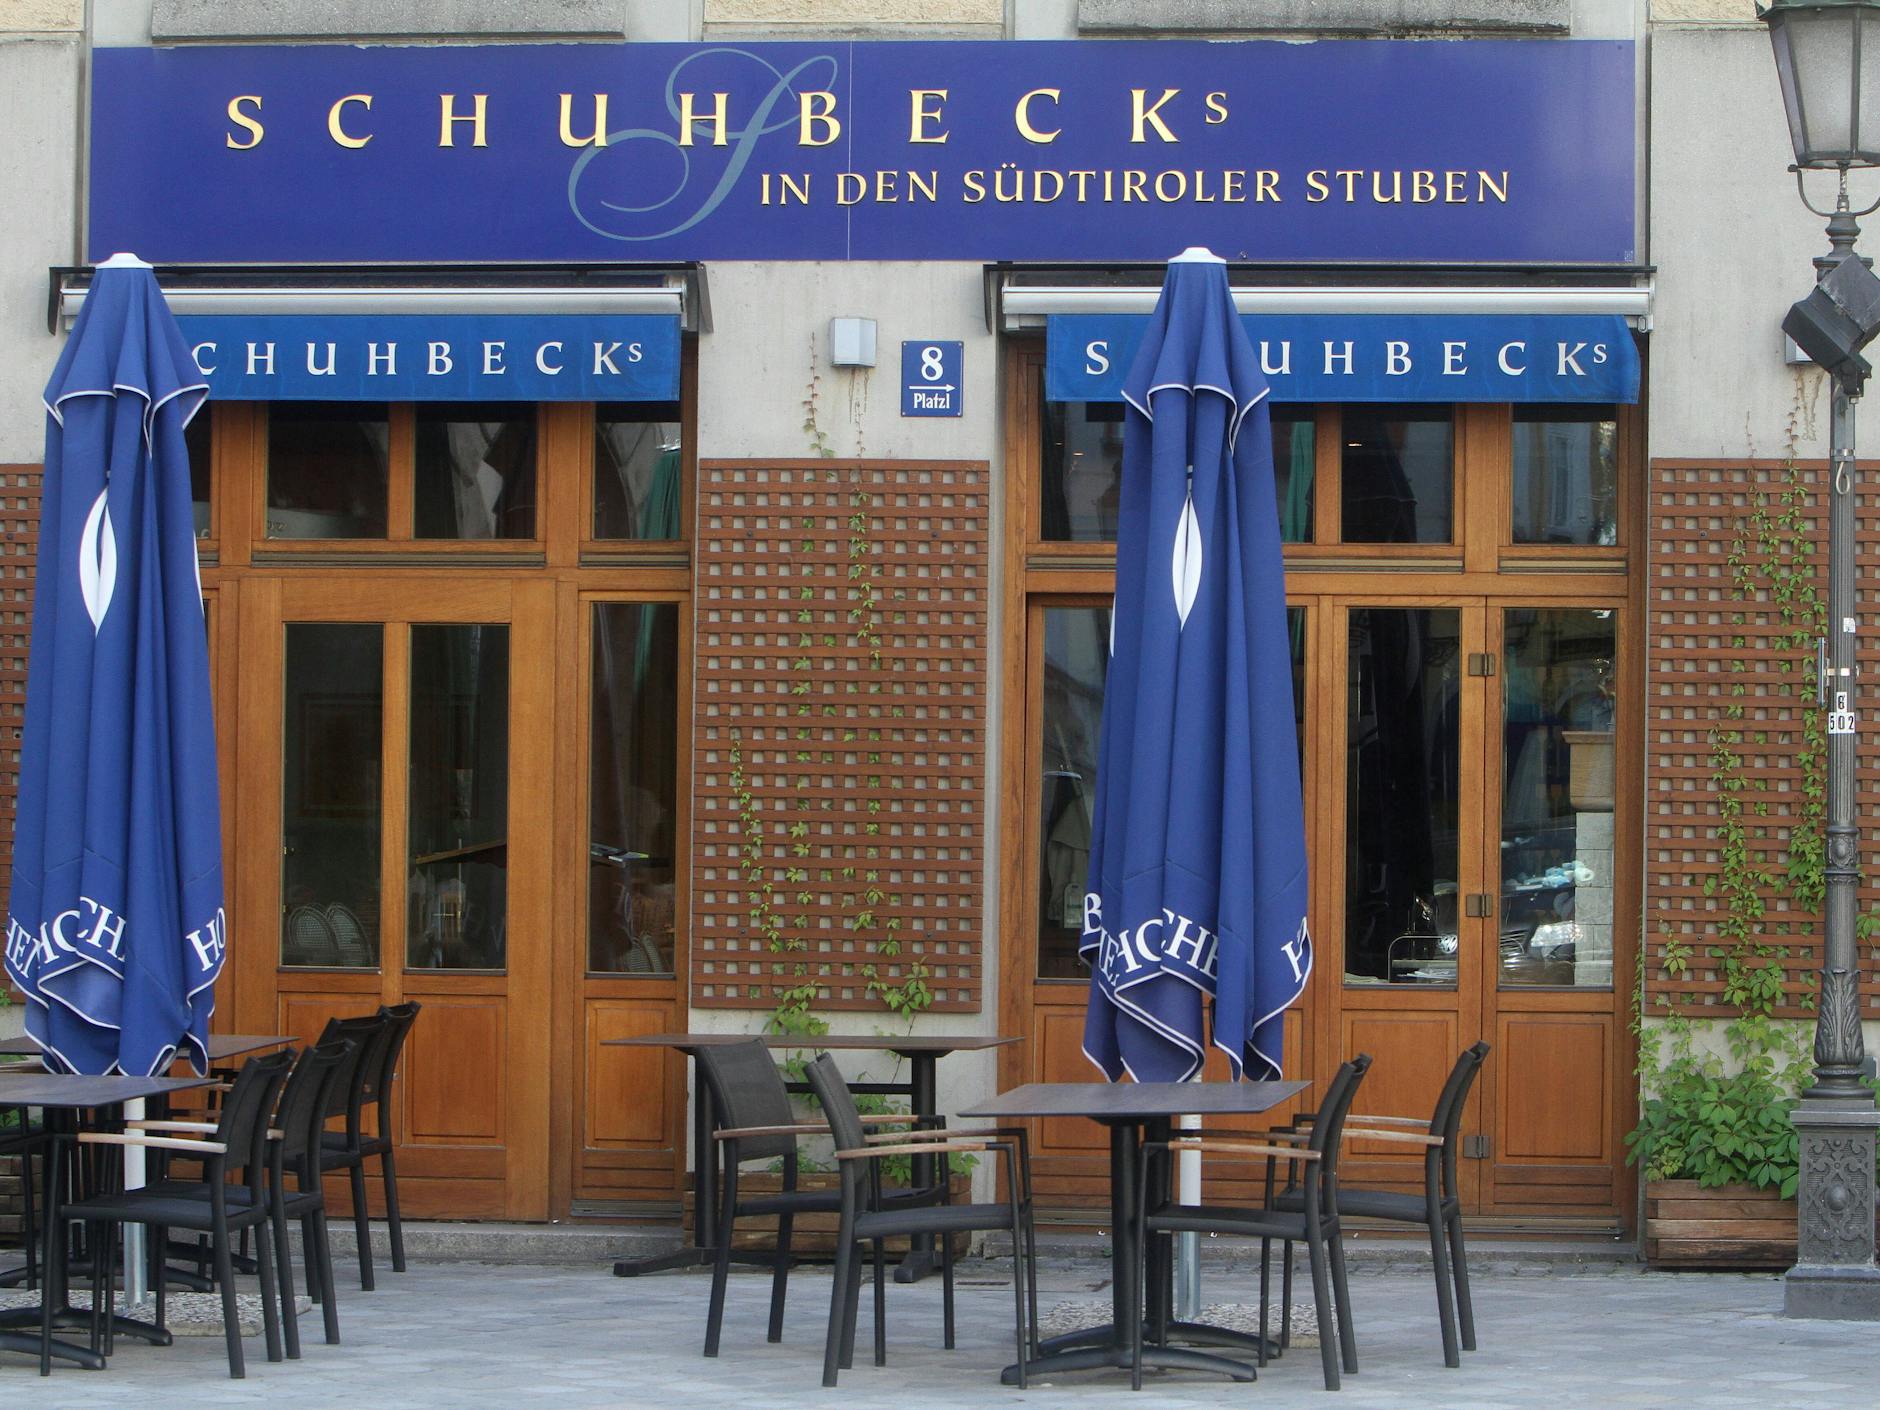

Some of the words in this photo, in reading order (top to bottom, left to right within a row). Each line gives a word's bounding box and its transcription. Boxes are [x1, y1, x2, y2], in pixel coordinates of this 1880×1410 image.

[761, 173, 810, 205] IN
[836, 170, 938, 205] DEN
[963, 162, 1282, 203] SÜDTIROLER
[1306, 169, 1508, 204] STUBEN
[921, 346, 944, 381] 8
[913, 392, 950, 409] Platzl
[1829, 714, 1855, 731] 502
